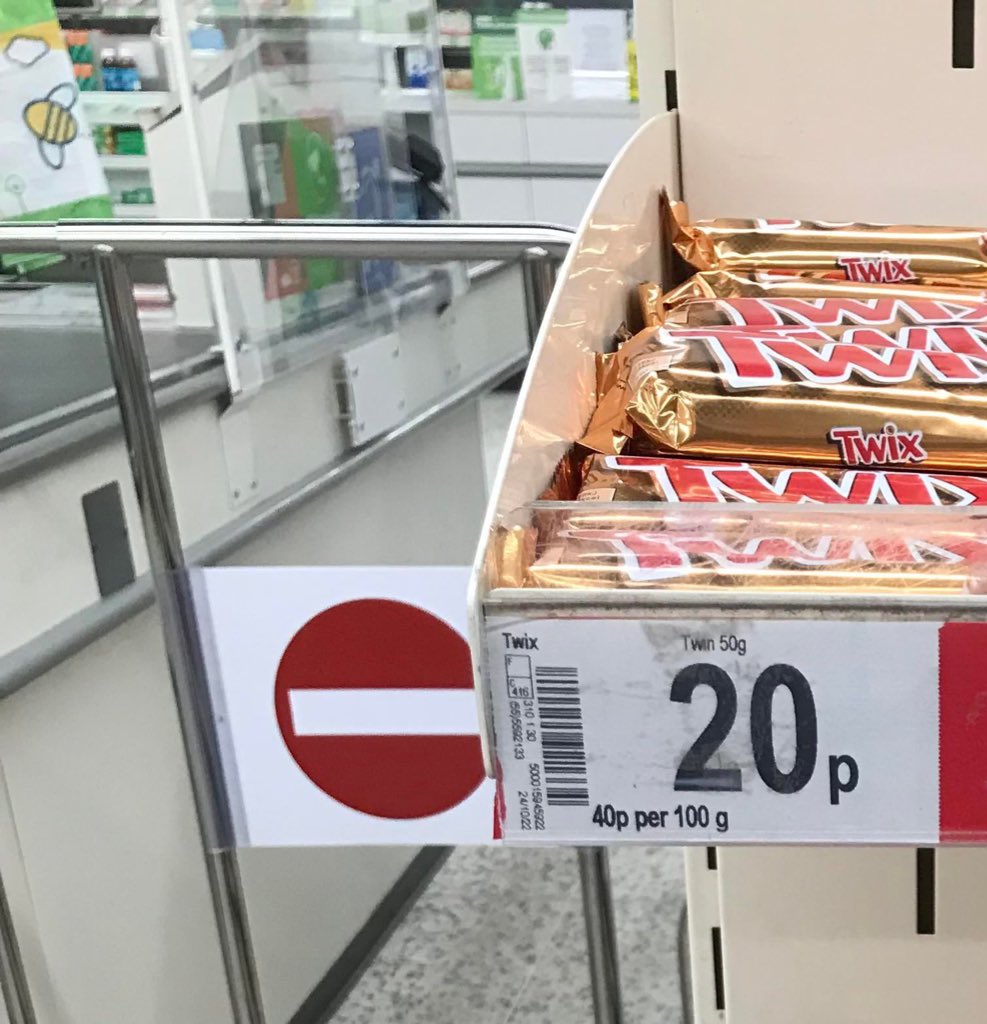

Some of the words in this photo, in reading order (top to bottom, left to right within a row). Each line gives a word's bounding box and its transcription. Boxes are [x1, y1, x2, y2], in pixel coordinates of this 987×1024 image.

[838, 252, 915, 282] Twix
[827, 422, 928, 466] Twix
[502, 633, 539, 650] Twix
[682, 635, 715, 652] Twin
[719, 635, 747, 656] 50g
[592, 804, 629, 830] 40p
[635, 808, 668, 829] per
[674, 804, 709, 828] 100
[714, 808, 730, 832] g
